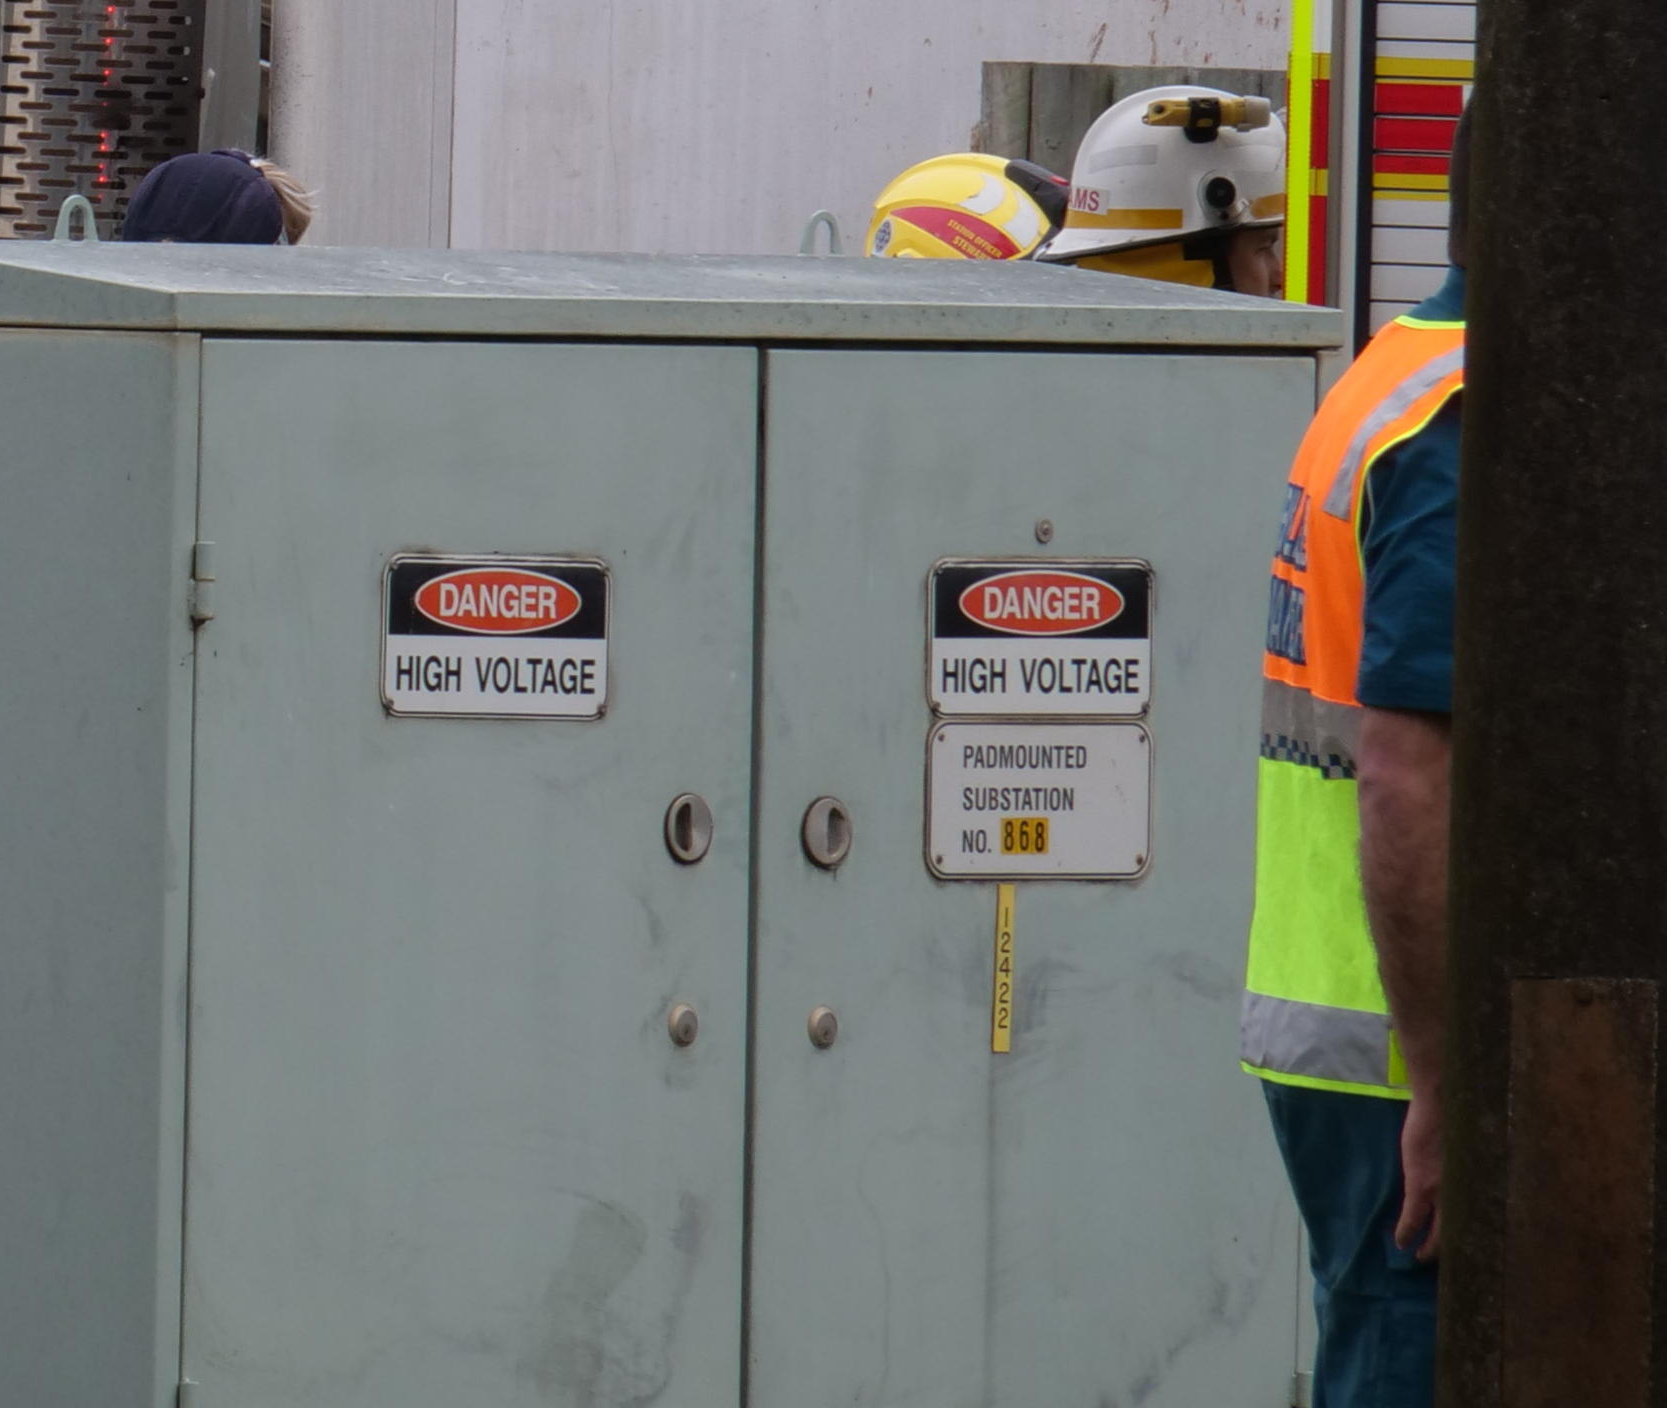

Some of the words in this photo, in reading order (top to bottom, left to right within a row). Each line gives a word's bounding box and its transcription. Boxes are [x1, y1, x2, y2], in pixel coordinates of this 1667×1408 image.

[947, 218, 975, 240] STATION
[973, 235, 1003, 258] OFFICER
[439, 582, 557, 619] DANGER
[983, 586, 1100, 620] DANGER
[396, 655, 462, 692] HIGH
[475, 657, 595, 694] VOLTAGE
[942, 658, 1006, 693] HIGH
[1020, 658, 1139, 694] VOLTAGE
[962, 744, 1087, 769] PADMOUNTED
[962, 787, 1075, 811] SUBSTATION
[961, 829, 992, 853] NO.
[1003, 820, 1046, 853] 868
[997, 907, 1012, 1029] 12422
